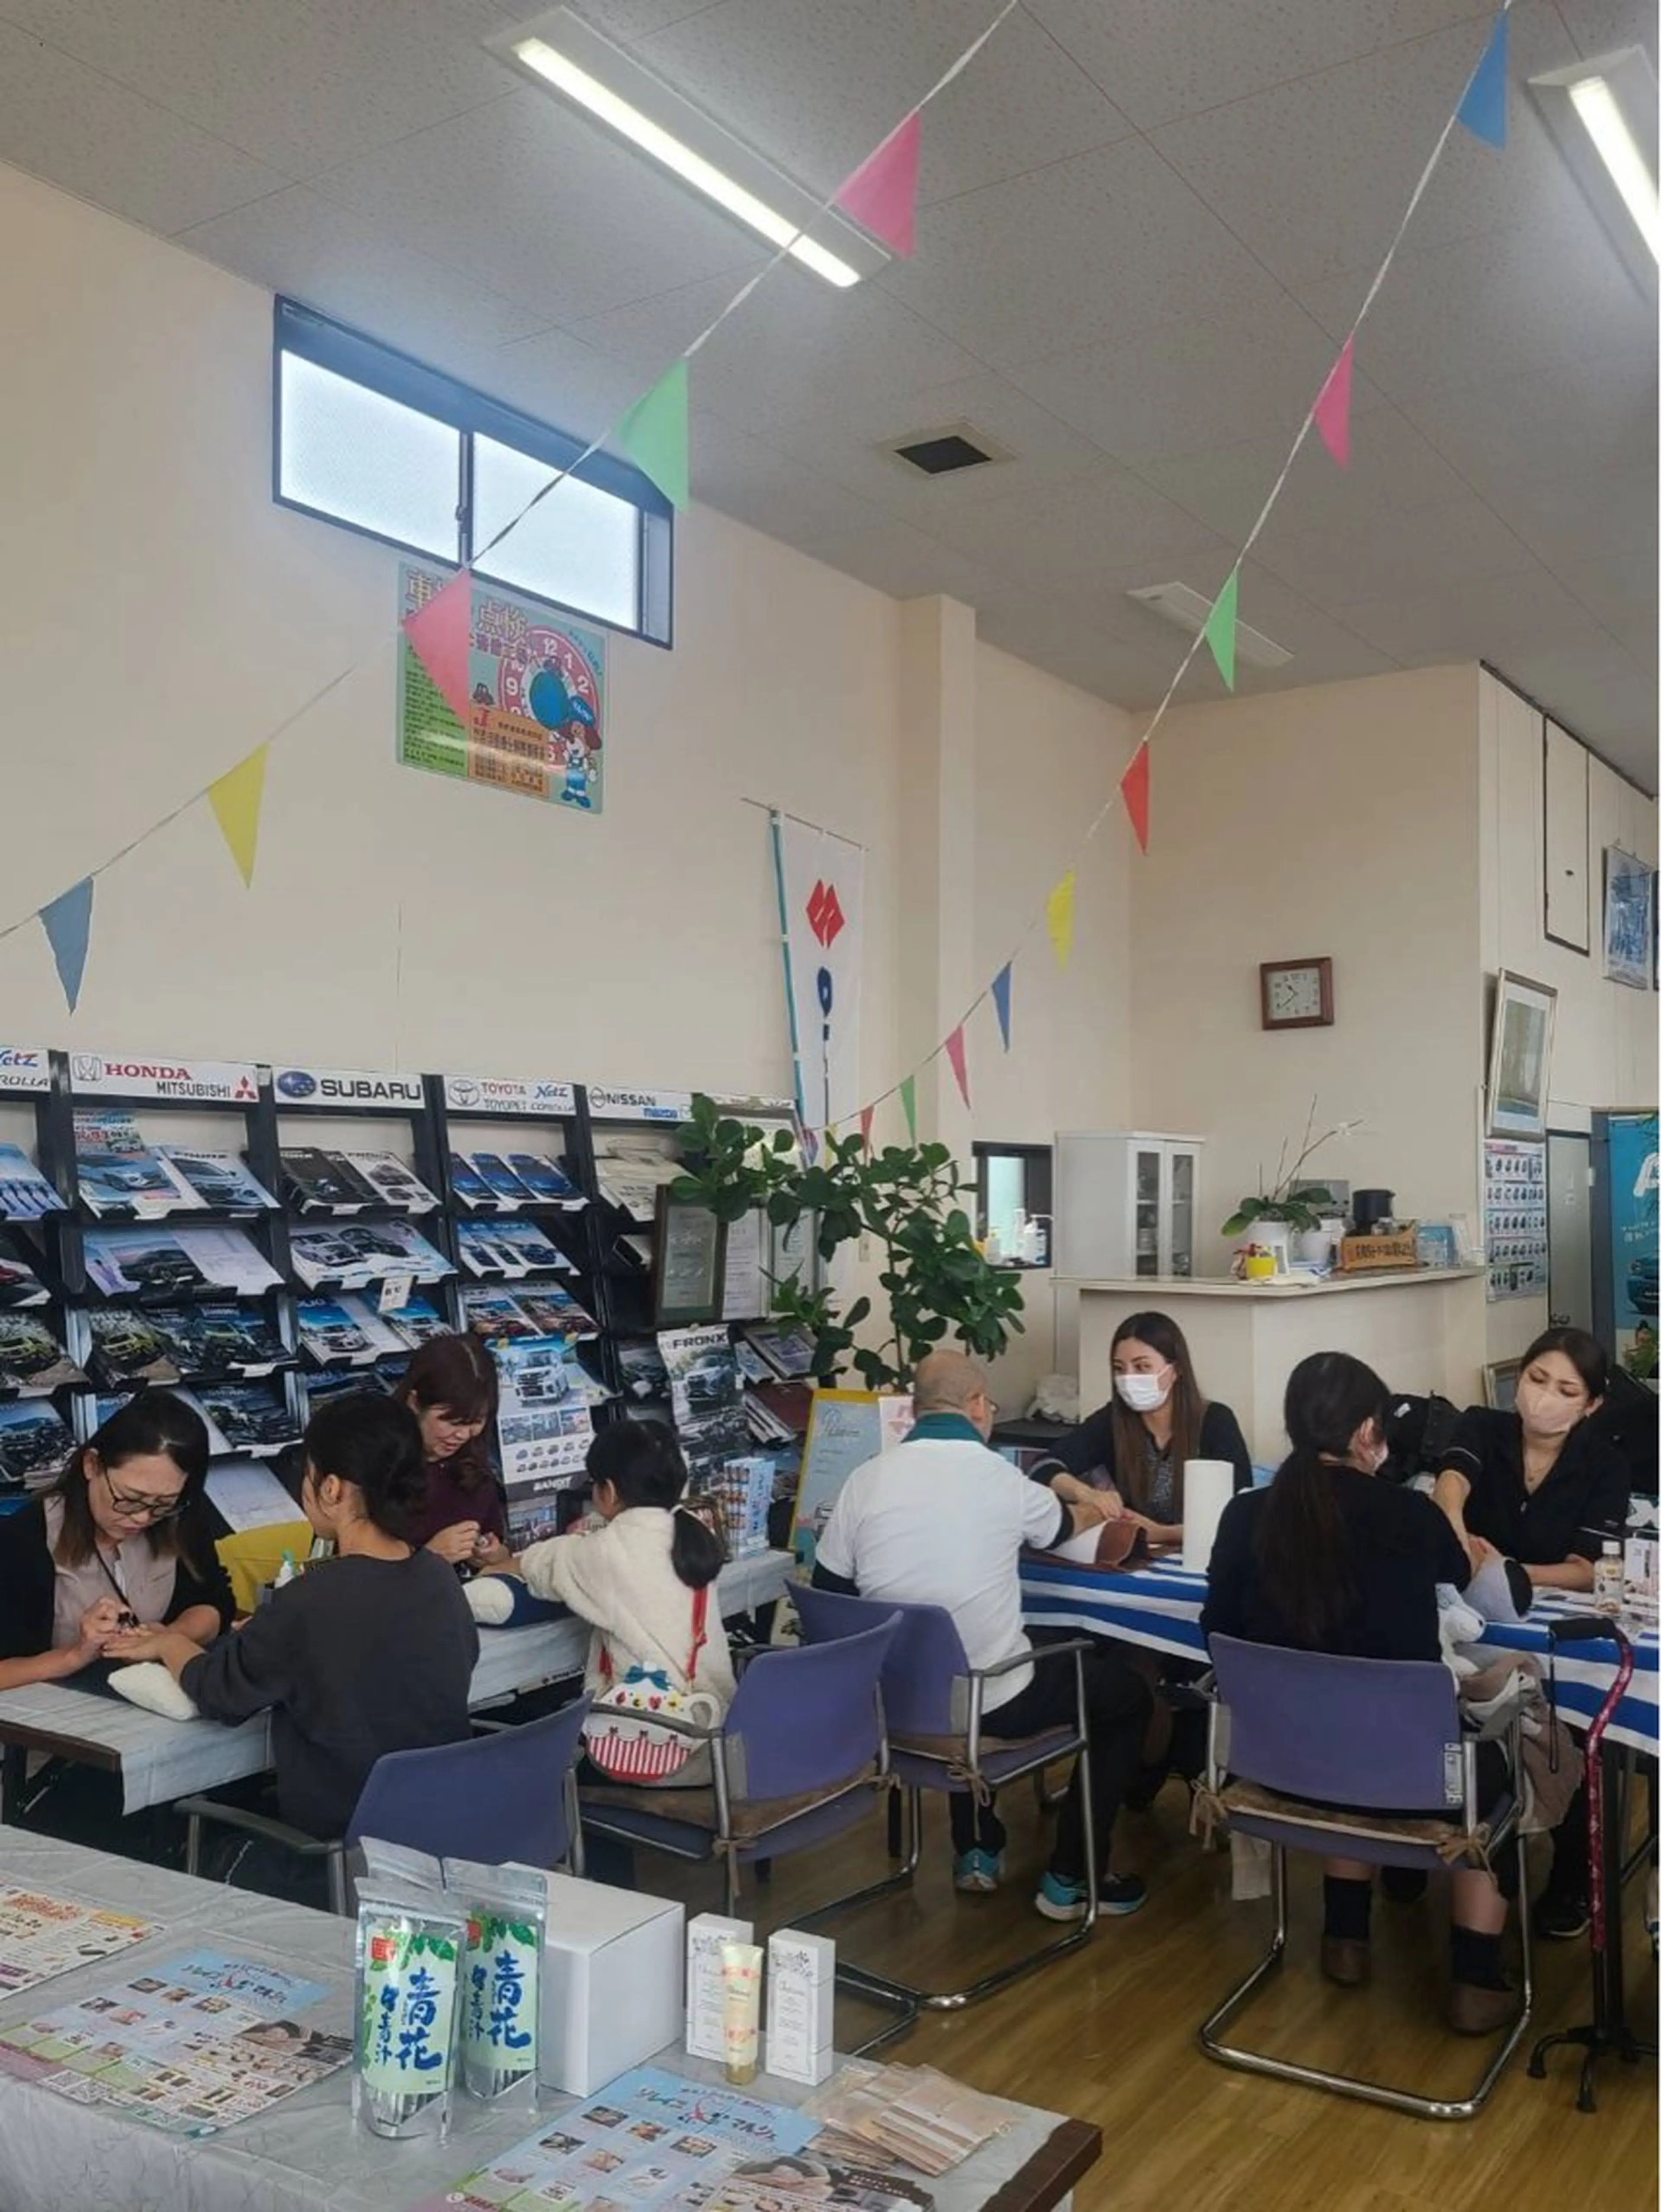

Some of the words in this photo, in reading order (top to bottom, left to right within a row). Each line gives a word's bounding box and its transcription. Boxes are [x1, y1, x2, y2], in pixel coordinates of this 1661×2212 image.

[505, 676, 519, 696] 9
[577, 675, 589, 695] 2
[104, 1063, 193, 1080] HONDA
[157, 1081, 230, 1098] MITSUBISHI
[321, 1080, 421, 1100] SUBARU
[481, 1082, 527, 1095] TOYOTA
[606, 1093, 656, 1106] NISSAN
[673, 1332, 726, 1349] FRONX
[487, 1949, 532, 2049] 青花
[395, 1966, 443, 2070] 青花
